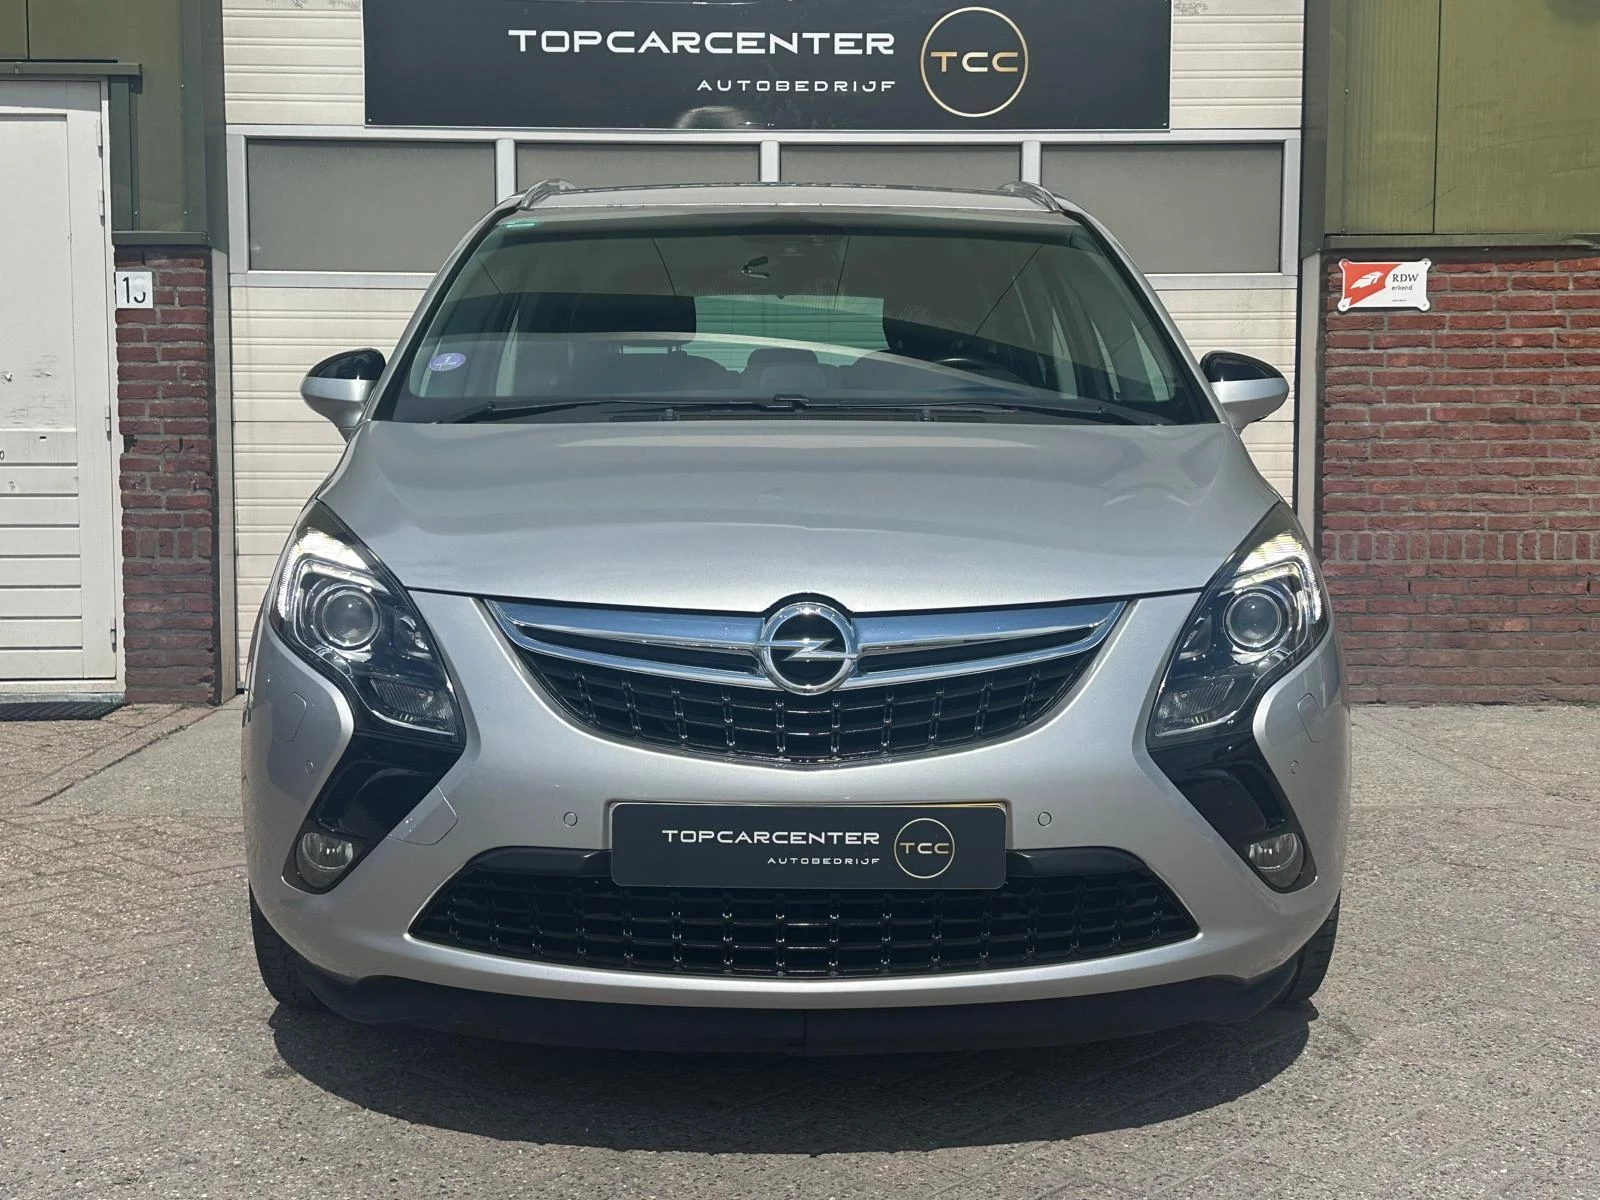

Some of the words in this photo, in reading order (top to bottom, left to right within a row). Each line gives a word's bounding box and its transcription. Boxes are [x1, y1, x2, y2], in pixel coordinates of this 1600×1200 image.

[507, 29, 895, 55] TOPCARCENTER
[930, 51, 1019, 73] TCC
[696, 79, 896, 93] AUTOBEDRIJF
[1392, 273, 1419, 283] RDW
[661, 829, 880, 845] TOPCARCENTER
[899, 842, 950, 855] TCC
[767, 857, 881, 865] AUTOBEDRIJF
